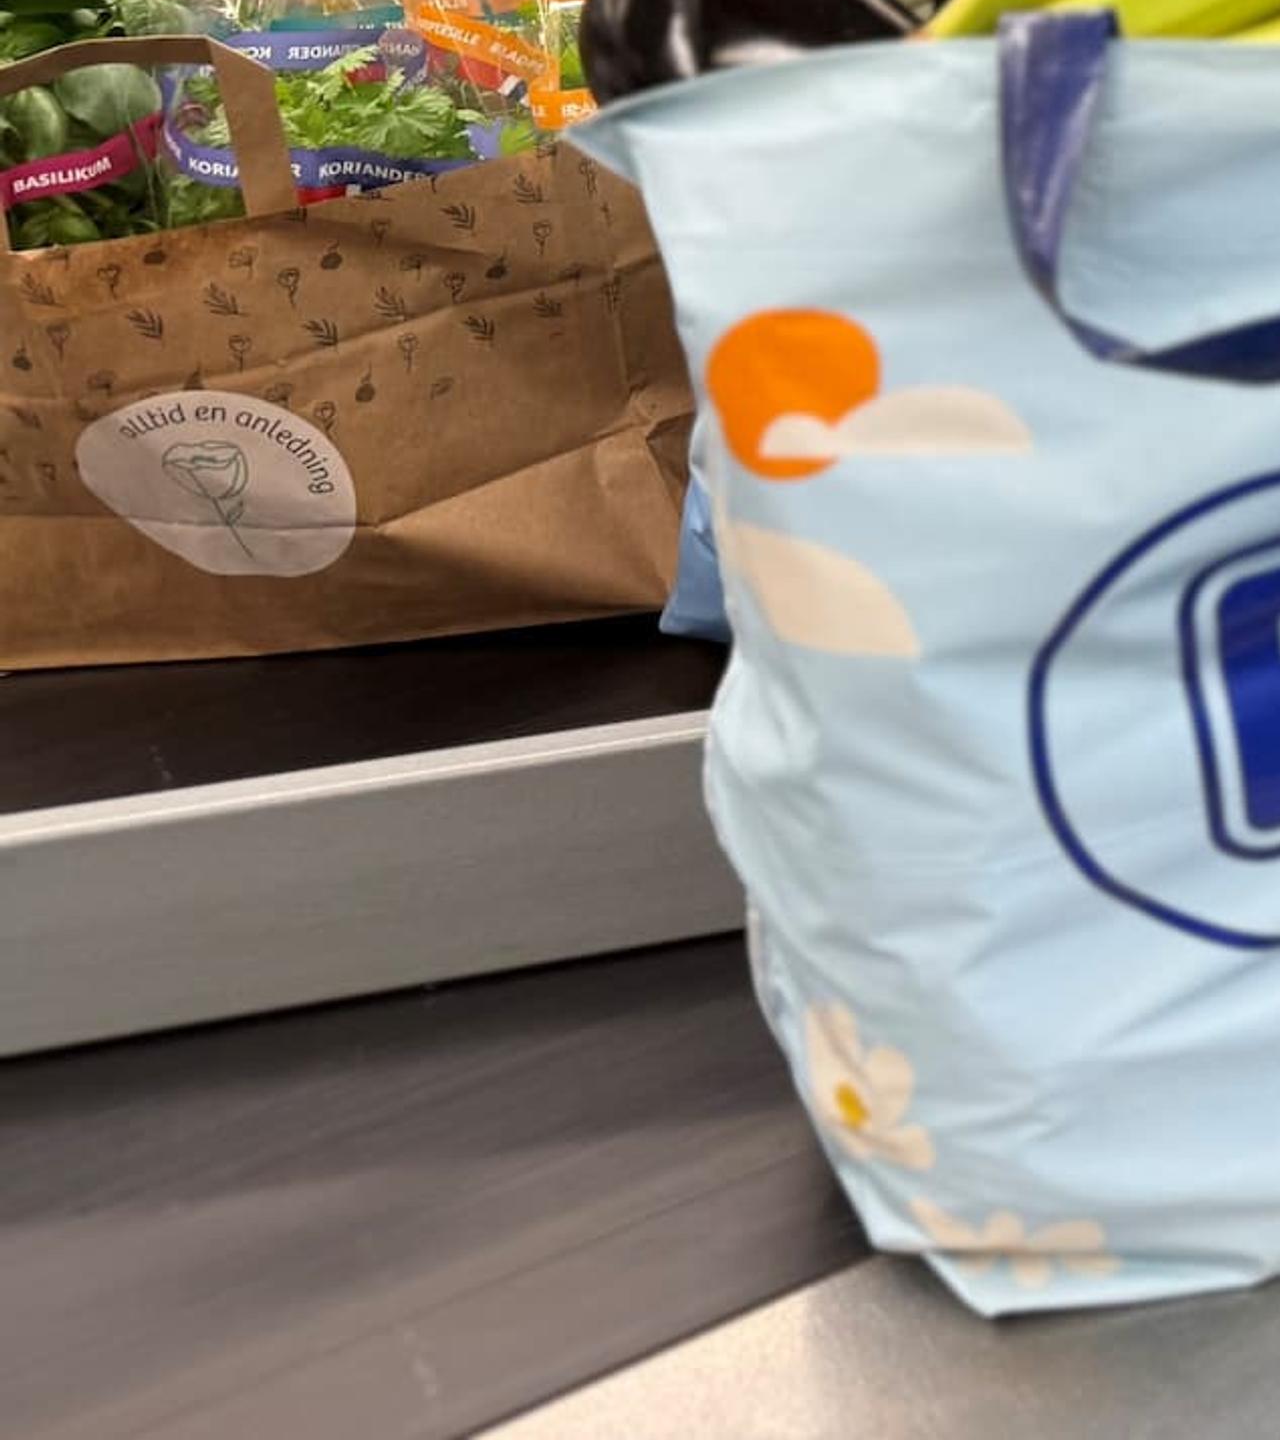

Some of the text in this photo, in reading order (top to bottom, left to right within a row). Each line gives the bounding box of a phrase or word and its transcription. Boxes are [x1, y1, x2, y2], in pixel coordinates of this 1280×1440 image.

[11, 156, 113, 194] BASILIKUM
[188, 157, 302, 179] KORIAR
[118, 402, 336, 496] alltid en anledning
